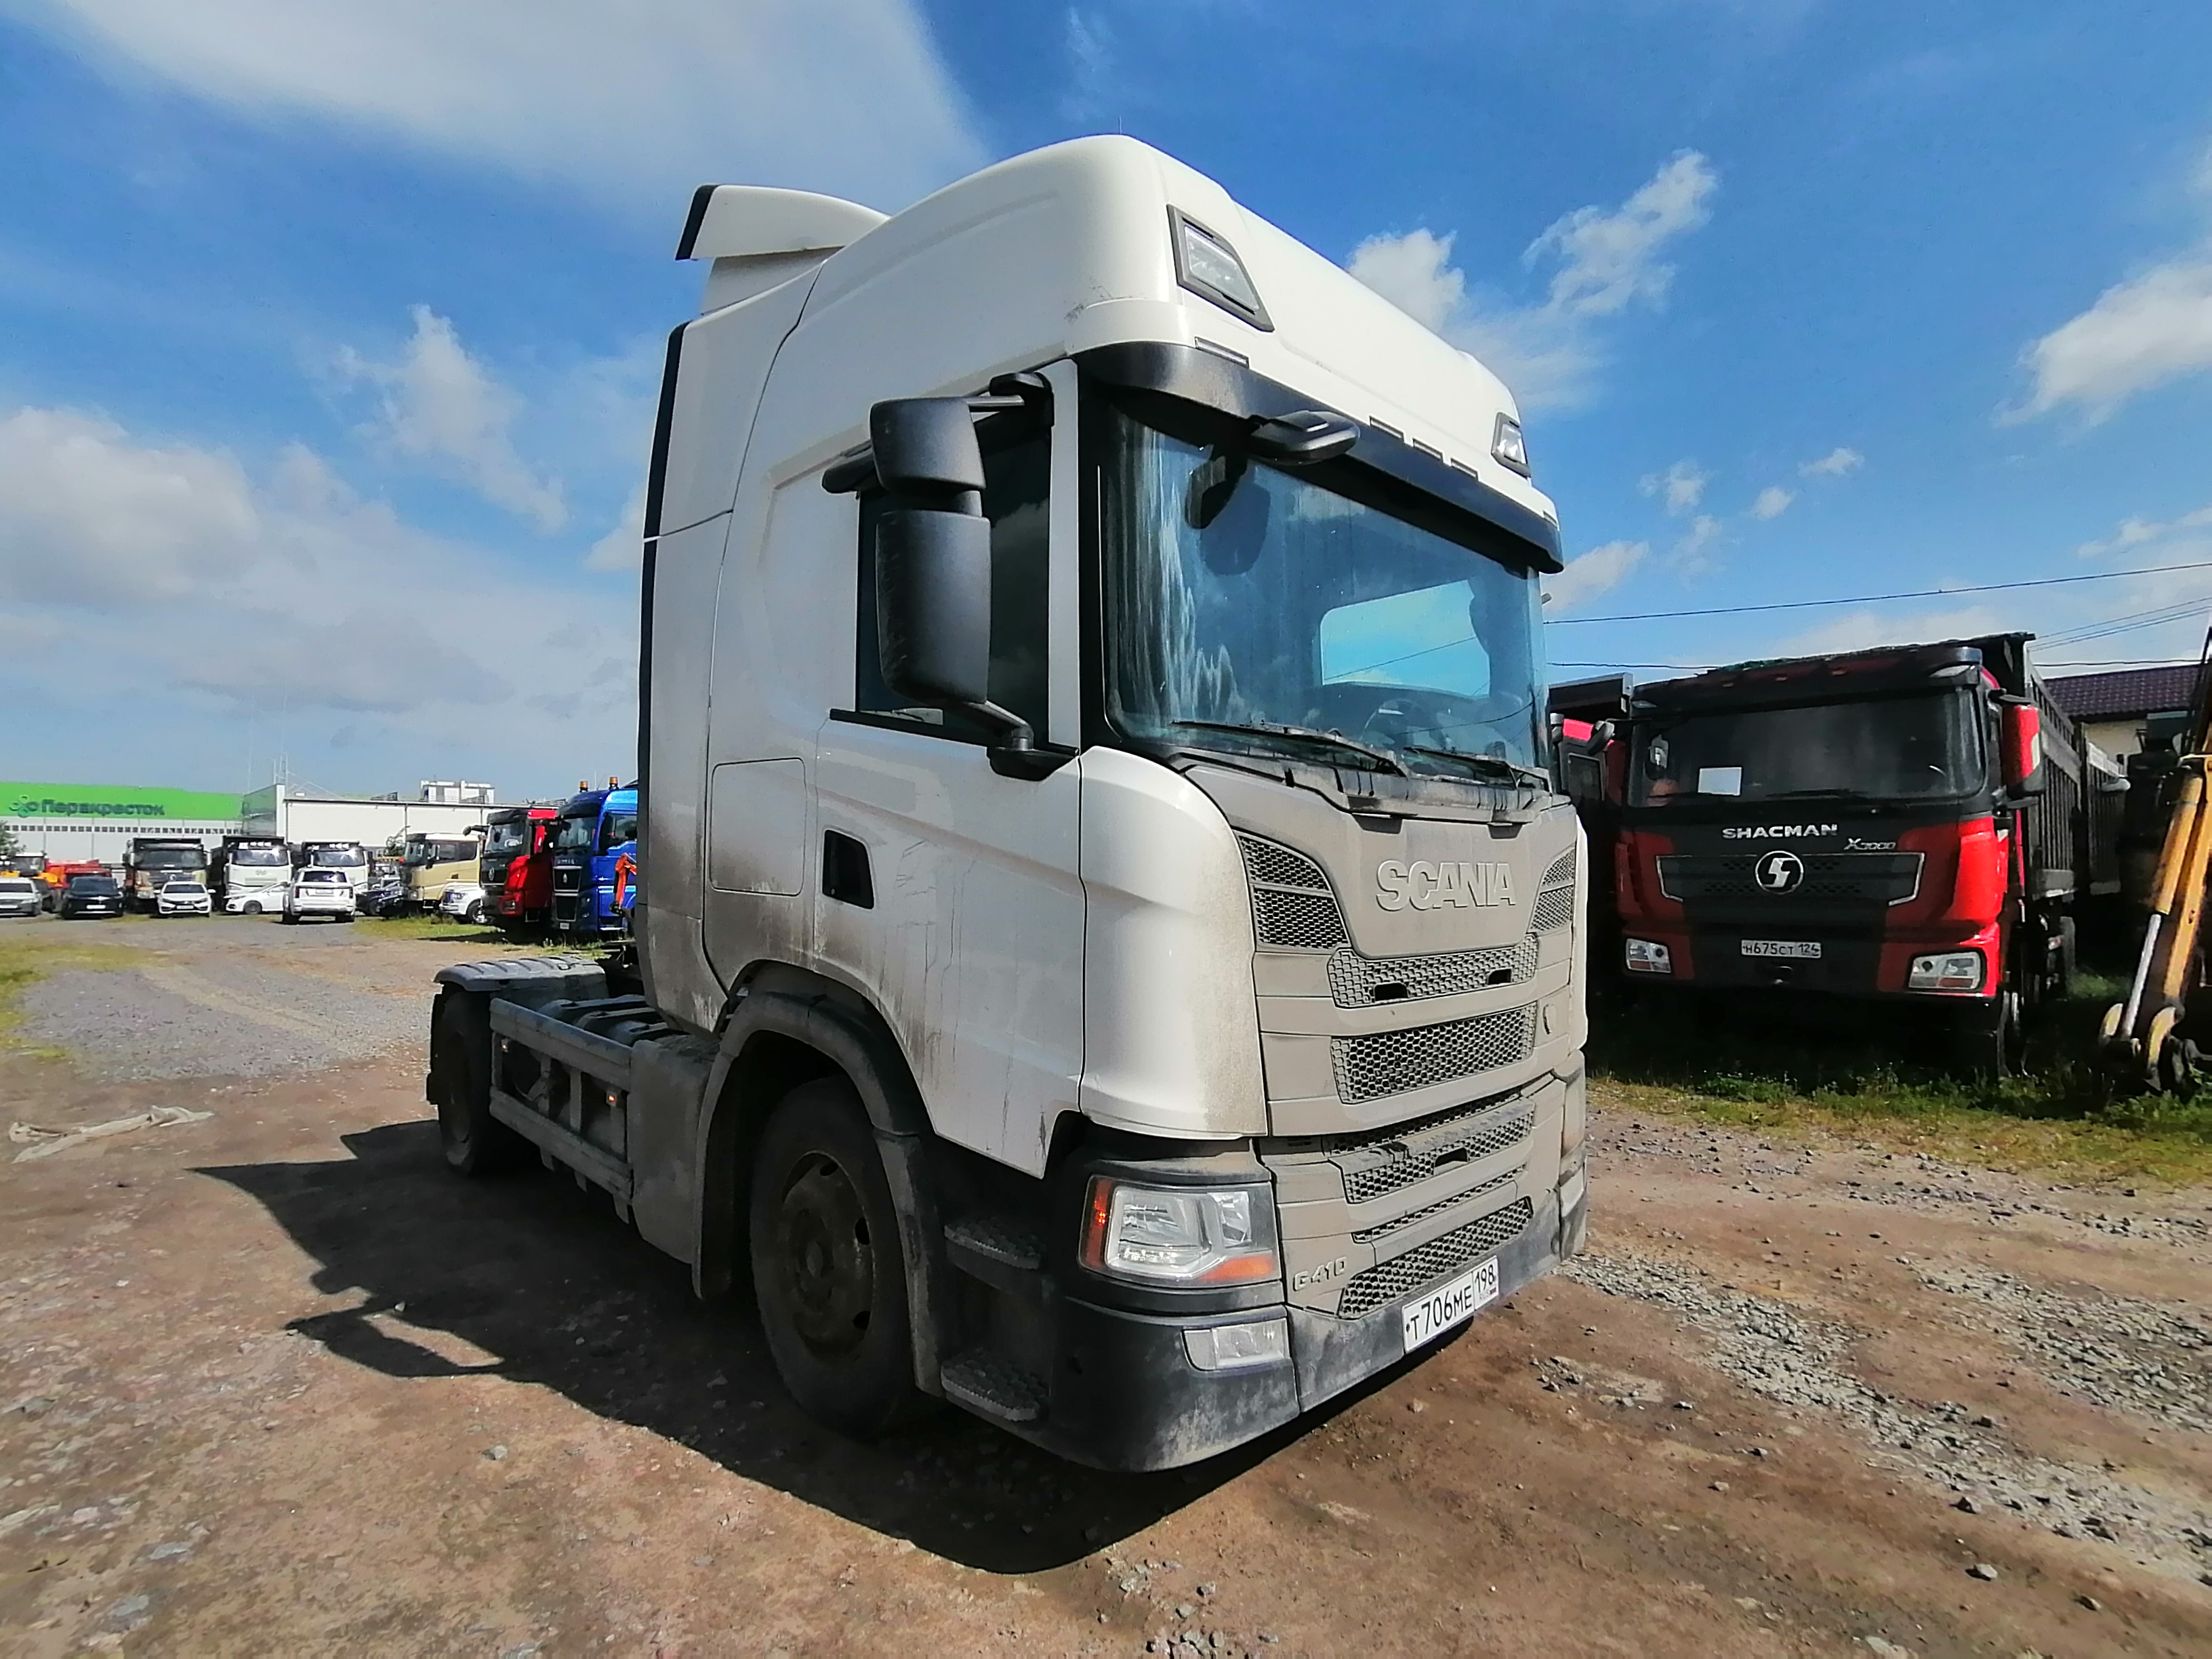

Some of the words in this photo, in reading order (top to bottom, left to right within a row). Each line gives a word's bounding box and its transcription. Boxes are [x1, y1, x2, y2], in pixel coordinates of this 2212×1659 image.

[1721, 823, 1838, 839] SHACMAN
[1376, 859, 1517, 912] SCANIA
[1292, 1256, 1347, 1292] G410
